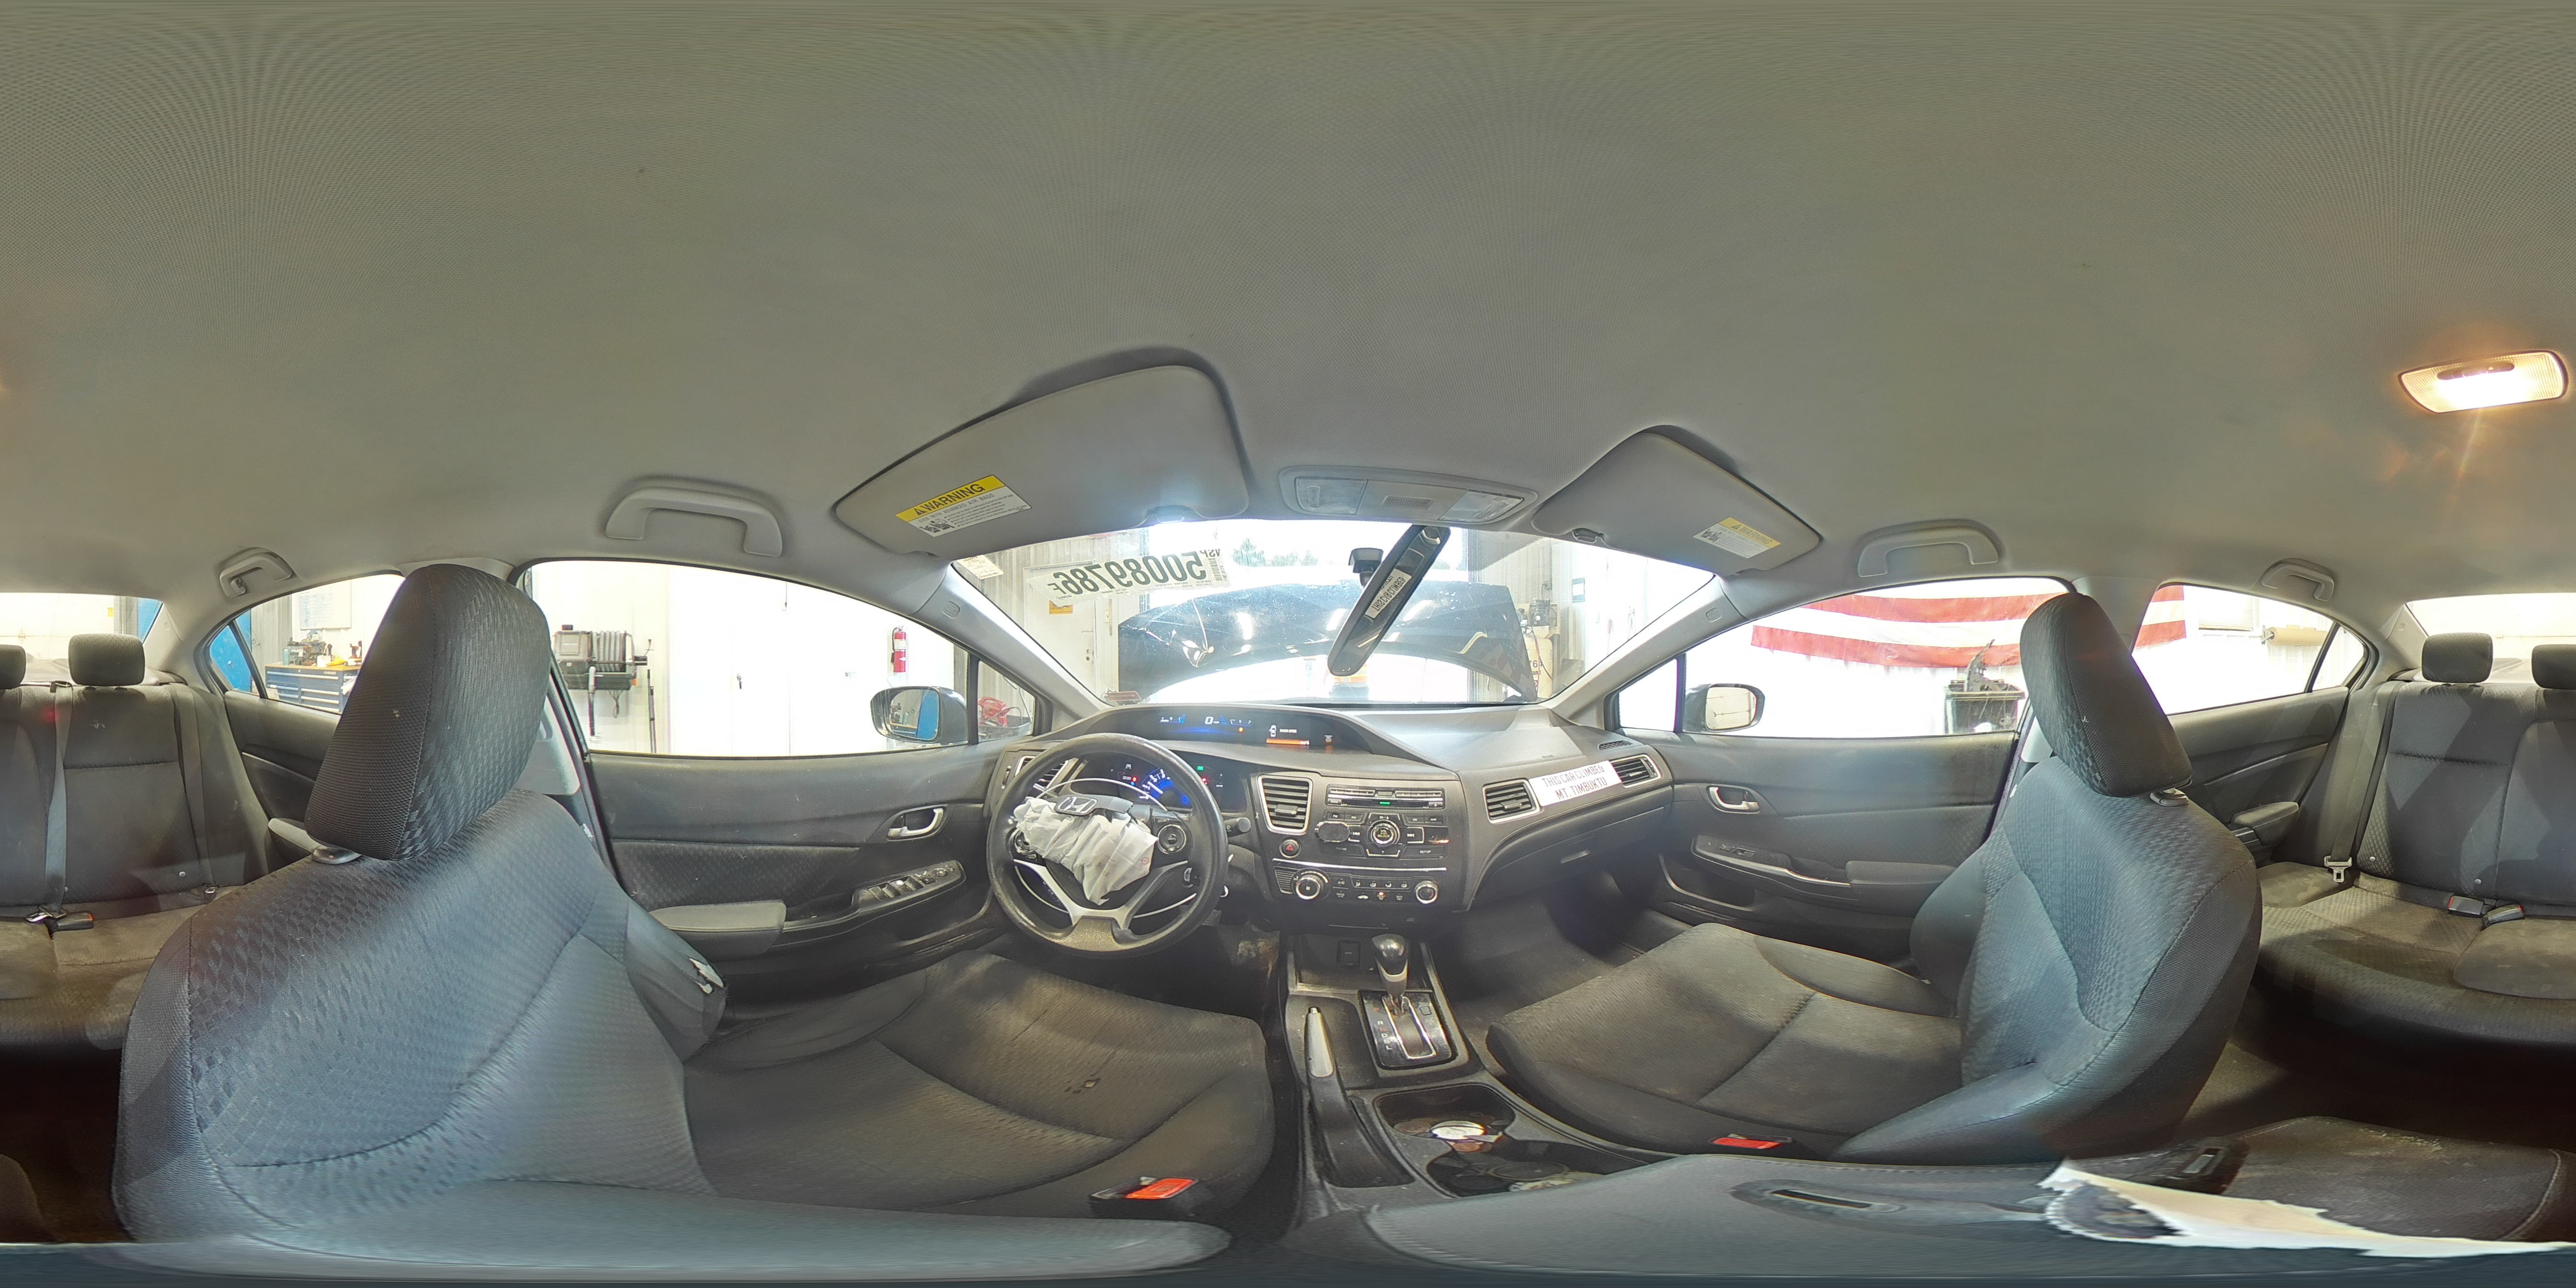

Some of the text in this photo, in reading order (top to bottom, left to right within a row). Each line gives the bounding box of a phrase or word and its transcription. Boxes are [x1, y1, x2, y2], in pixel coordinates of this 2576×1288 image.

[920, 484, 985, 511] WARNING
[943, 503, 967, 514] ADVANCED
[1738, 526, 1772, 545] WARNING
[1542, 765, 1605, 787] THIS CAR CLIMBED
[1555, 776, 1608, 800] MT. TIMBUKTU
